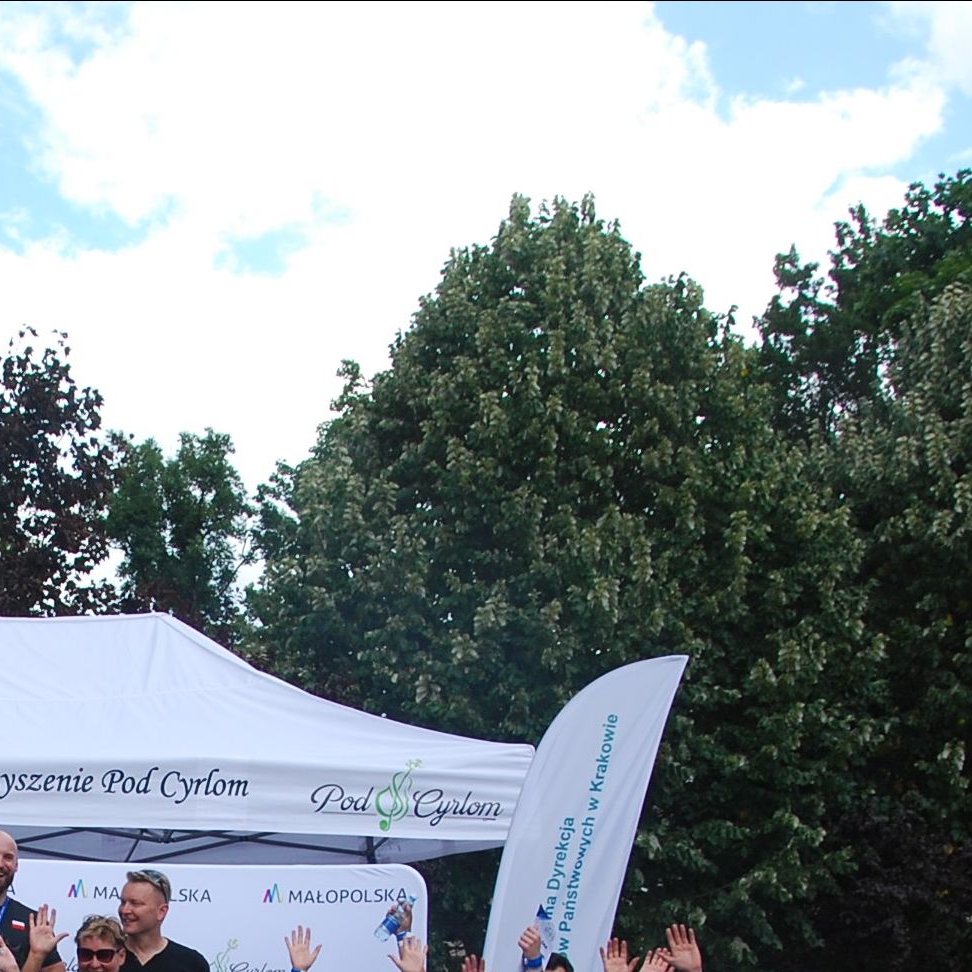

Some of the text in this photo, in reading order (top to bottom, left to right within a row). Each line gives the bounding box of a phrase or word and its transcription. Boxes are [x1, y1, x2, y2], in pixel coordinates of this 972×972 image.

[589, 713, 619, 793] Krakowie
[101, 766, 159, 795] Pod
[160, 768, 249, 804] Cyrlom
[311, 784, 504, 826] Pod Cyrlom
[588, 798, 600, 811] w
[547, 816, 575, 890] Dyrekcja
[559, 816, 596, 932] Państwowych
[288, 887, 407, 904] MAŁOPOLSKA
